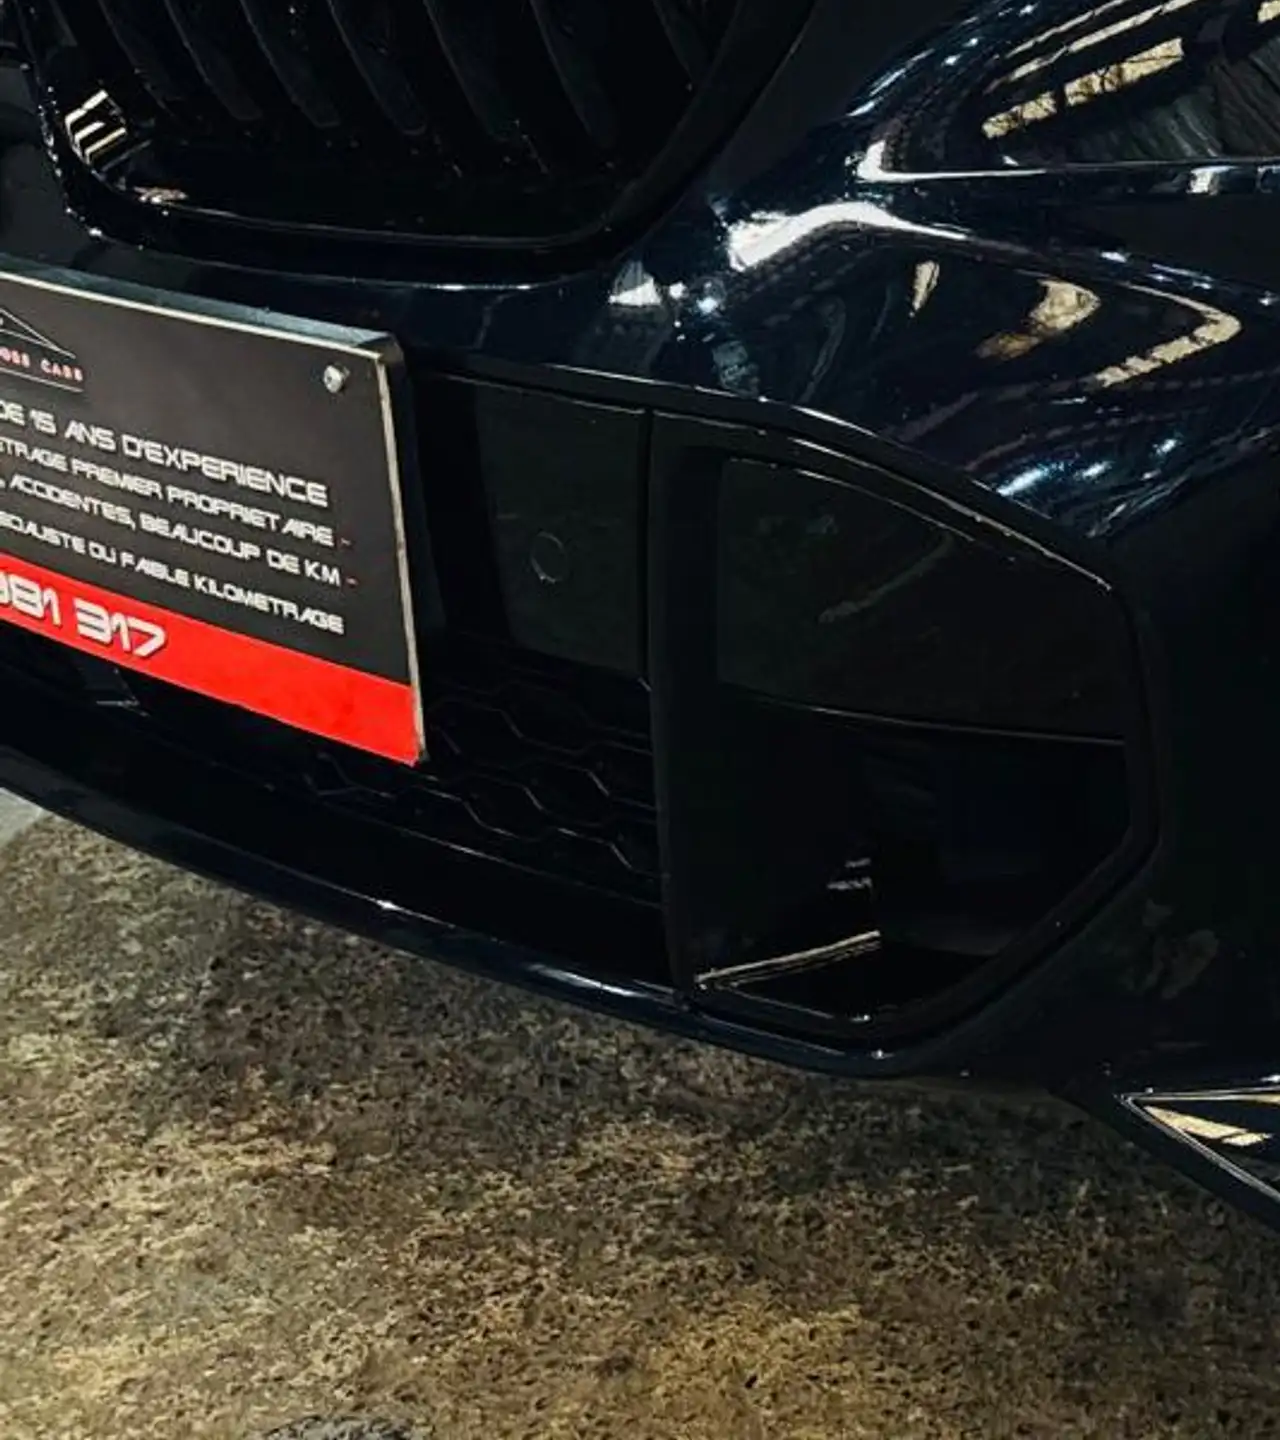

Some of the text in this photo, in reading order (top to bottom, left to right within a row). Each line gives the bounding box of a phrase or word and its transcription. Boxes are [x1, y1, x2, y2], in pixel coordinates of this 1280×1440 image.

[64, 420, 116, 452] ANS
[71, 457, 163, 500] PREMIER
[139, 513, 261, 561] BEAUCOUP
[266, 550, 301, 576] DE
[88, 541, 117, 563] DU
[194, 573, 345, 636] KILOMETRAGE
[74, 597, 166, 657] 317
